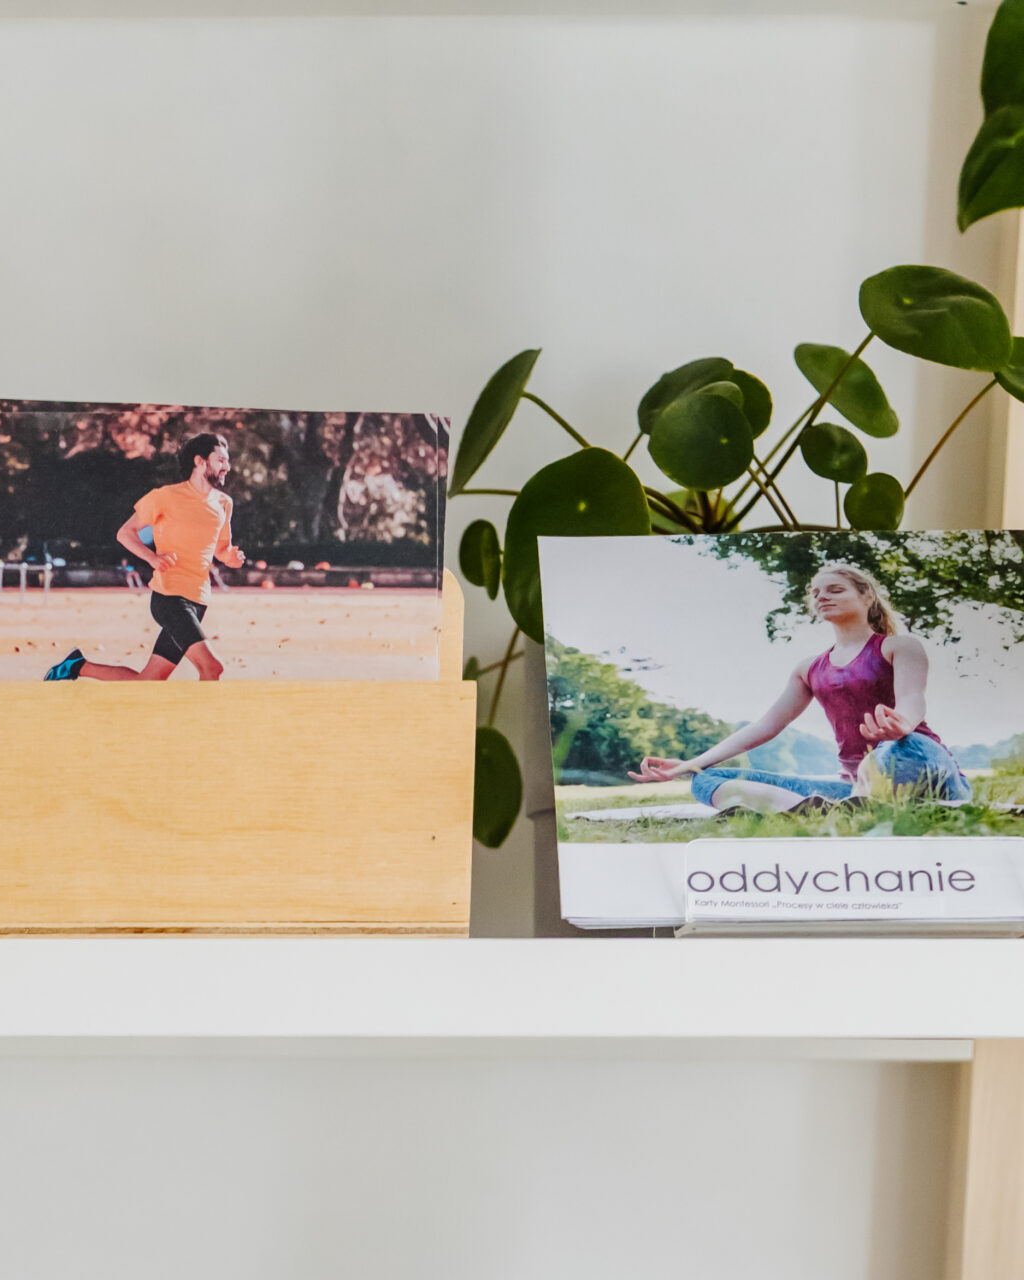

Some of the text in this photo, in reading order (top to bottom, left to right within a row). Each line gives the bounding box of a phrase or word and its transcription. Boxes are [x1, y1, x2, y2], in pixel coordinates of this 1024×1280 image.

[686, 861, 976, 895] oddychanie
[694, 899, 718, 909] Karty
[720, 900, 770, 909] Montessori
[825, 901, 849, 910] ciele
